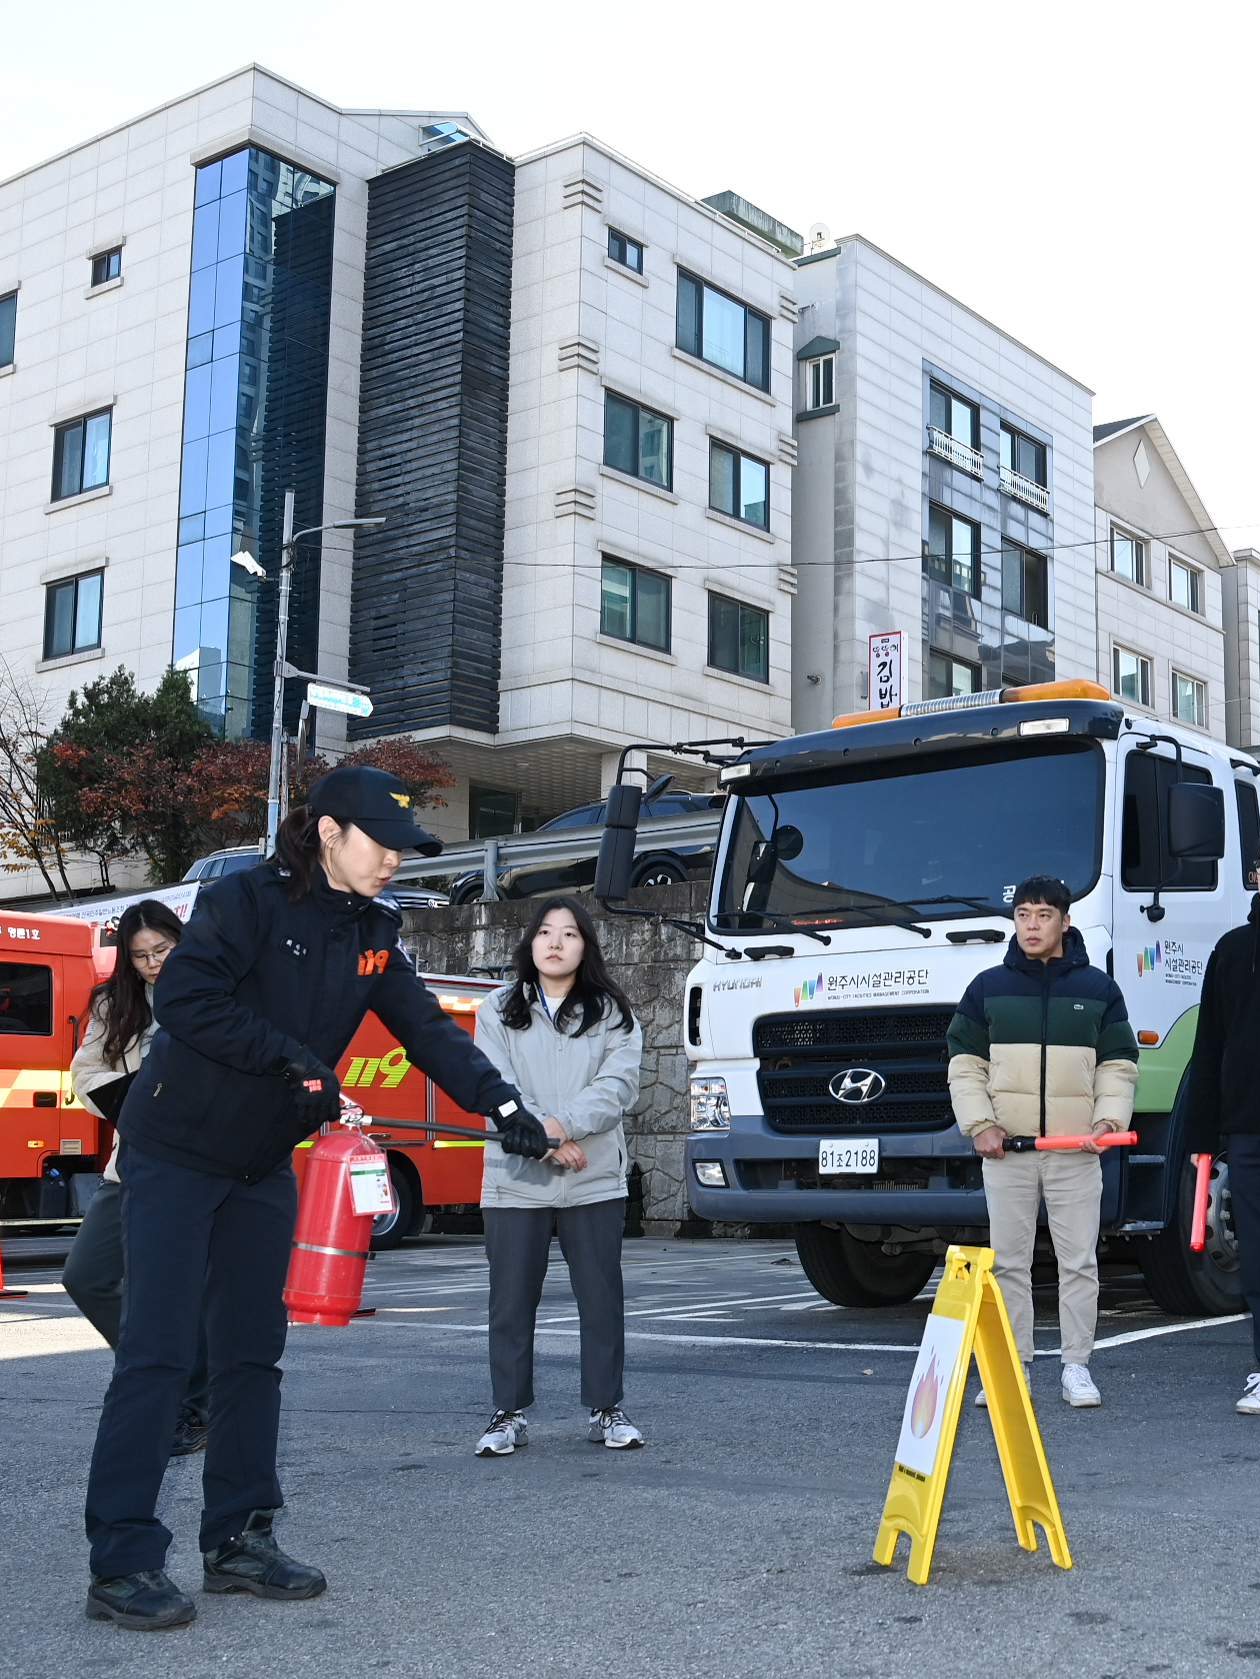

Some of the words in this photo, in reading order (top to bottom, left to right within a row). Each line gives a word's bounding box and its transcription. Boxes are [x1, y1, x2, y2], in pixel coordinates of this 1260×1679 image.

[876, 658, 898, 709] 김밥
[1164, 940, 1184, 956] 원주시
[1164, 957, 1203, 975] 시설관리공단
[712, 976, 763, 992] HYUNDAI
[827, 969, 930, 991] 원주시시설관리공단
[341, 1046, 412, 1088] 119
[821, 1149, 876, 1168] 81조2188
